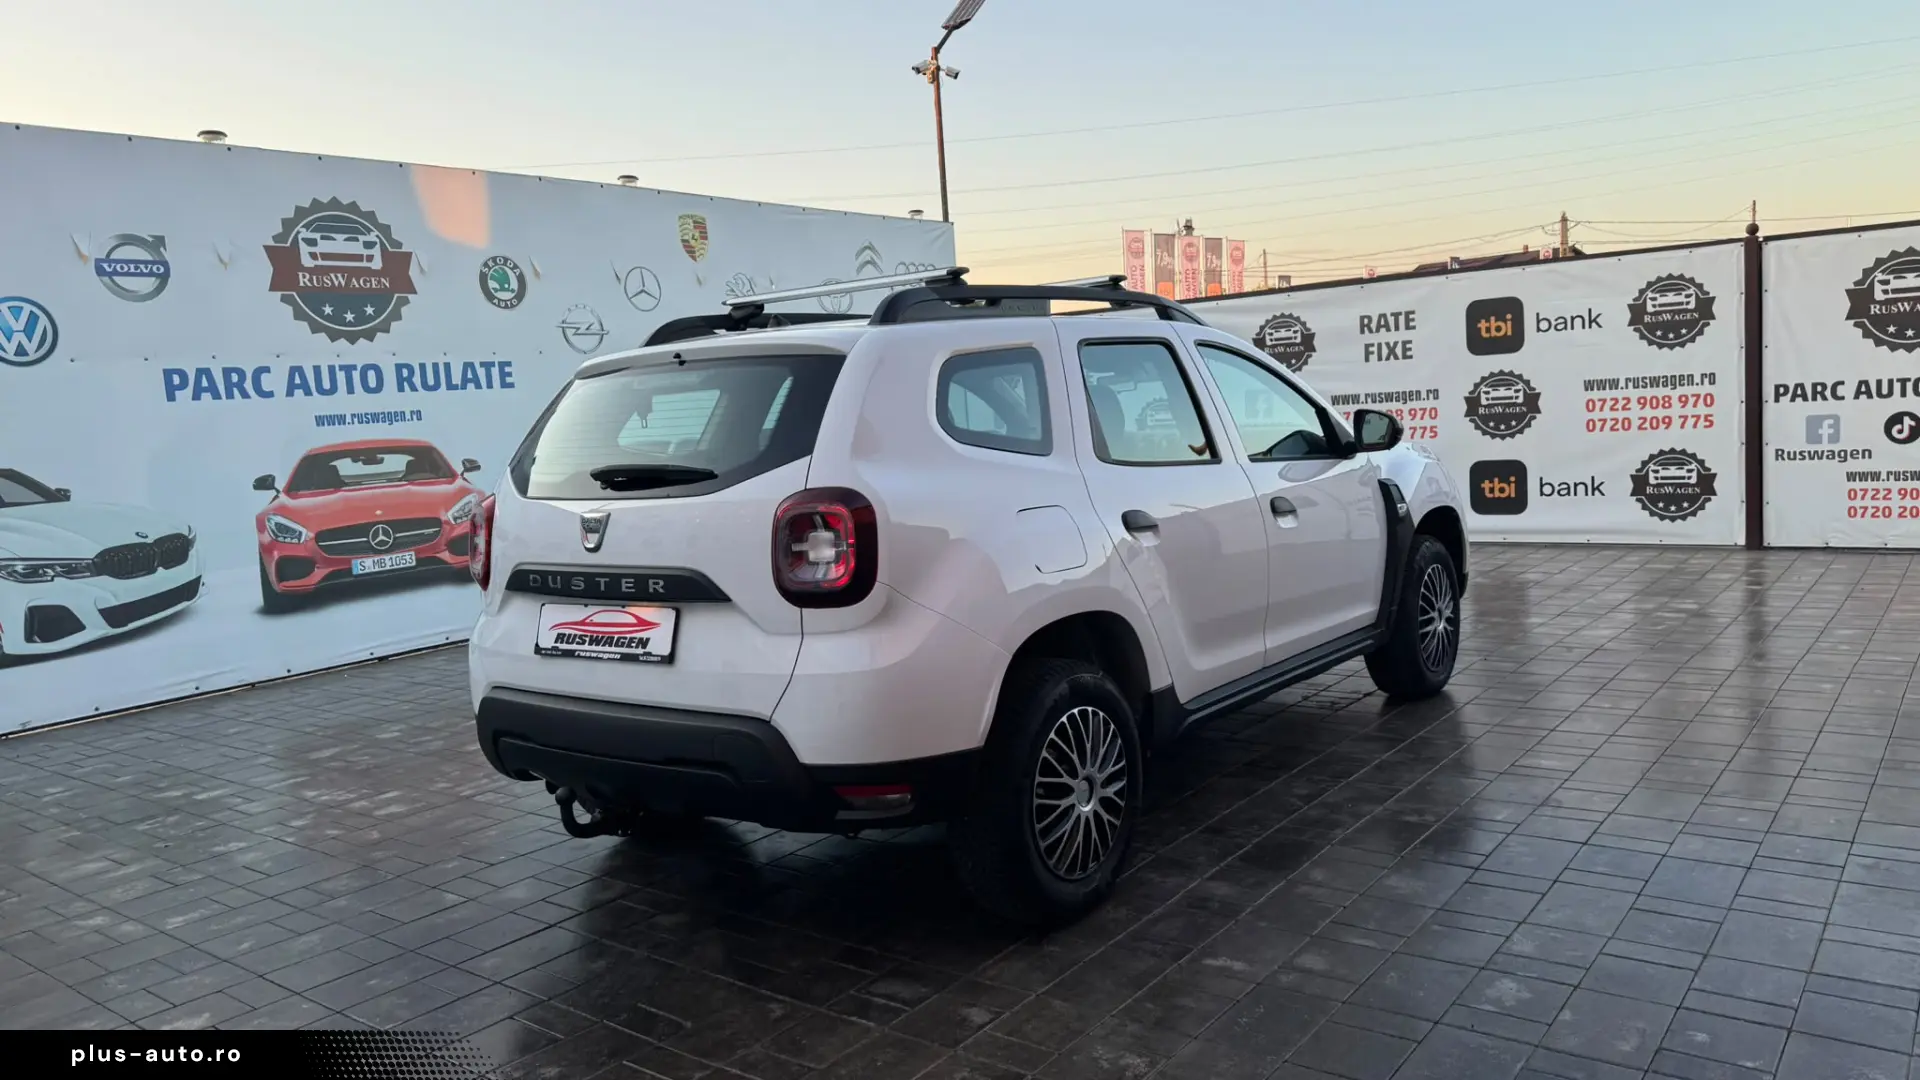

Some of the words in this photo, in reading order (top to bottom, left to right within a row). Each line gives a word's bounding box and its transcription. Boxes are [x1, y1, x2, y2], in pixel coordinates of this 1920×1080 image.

[100, 262, 165, 274] VOLVO
[481, 257, 521, 276] SKODA
[297, 272, 391, 289] RUSWAGEN
[493, 298, 518, 308] AUTO
[1359, 310, 1416, 335] RATE
[1477, 313, 1513, 339] tbi
[1535, 308, 1604, 334] bank
[1643, 311, 1699, 323] RUSWAGEN
[1364, 340, 1414, 363] FIXE
[162, 365, 275, 402] PARC
[285, 363, 385, 398] AUTO
[394, 361, 516, 393] RULATE
[1583, 372, 1716, 391] www.ruswagen.ro
[1331, 388, 1439, 405] www.ruswagen.ro
[1773, 380, 1846, 403] PARC
[1478, 405, 1527, 414] RUSWAGEN
[1585, 396, 1632, 413] 0722
[1636, 394, 1673, 411] 908
[1677, 392, 1715, 409] 970
[315, 409, 422, 427] www.ruswagen.ro
[1408, 407, 1438, 421] 970
[1585, 416, 1632, 433] 0720
[1637, 415, 1673, 430] 209
[1678, 413, 1715, 429] 775
[1408, 425, 1438, 439] 775
[1774, 448, 1873, 463] Ruswagen
[1480, 476, 1516, 498] tbi
[1539, 476, 1606, 497] bank
[1645, 485, 1701, 495] RUSWAGEN
[1847, 488, 1892, 501] 0722
[1897, 487, 1920, 501] 90
[1847, 505, 1892, 519] 0720
[1897, 505, 1920, 519] 20
[372, 557, 387, 570] MB
[529, 574, 666, 593] DUSTER
[553, 632, 651, 650] RUSWAGEN
[574, 650, 621, 660] ruswagen
